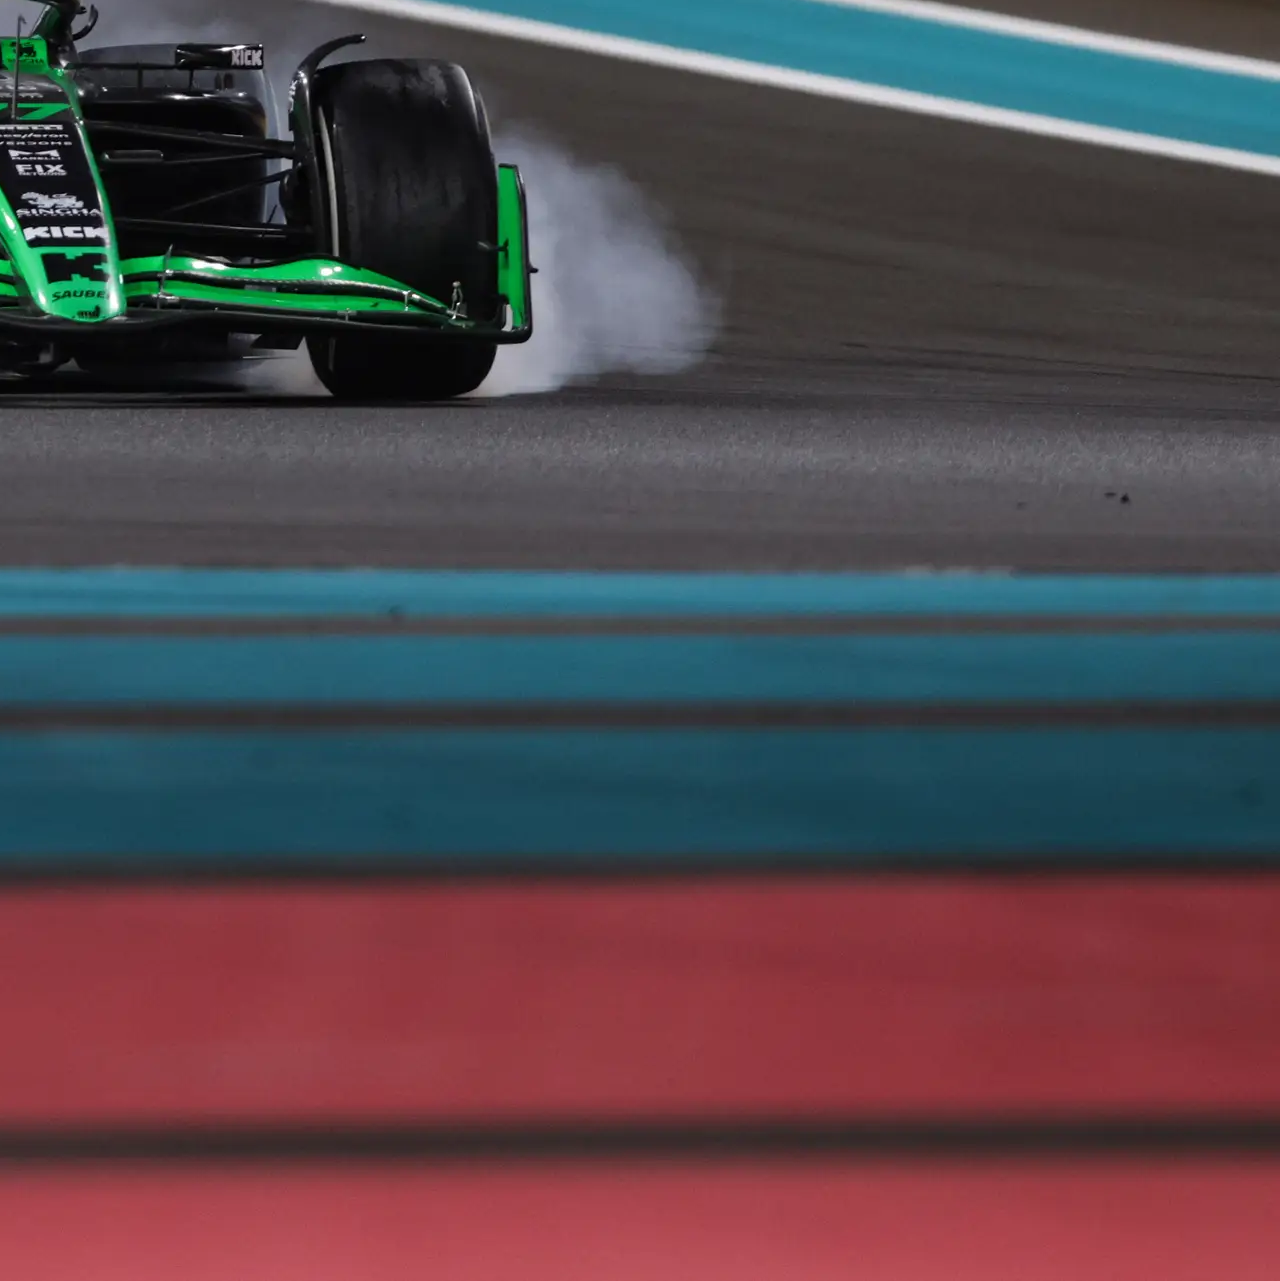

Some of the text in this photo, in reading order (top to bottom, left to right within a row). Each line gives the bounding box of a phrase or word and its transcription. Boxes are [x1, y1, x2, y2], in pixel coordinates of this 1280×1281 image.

[231, 49, 262, 66] KICK
[15, 164, 67, 174] FIX
[16, 208, 104, 217] SINGHA
[23, 226, 108, 241] KICK
[52, 289, 108, 302] SAUBE
